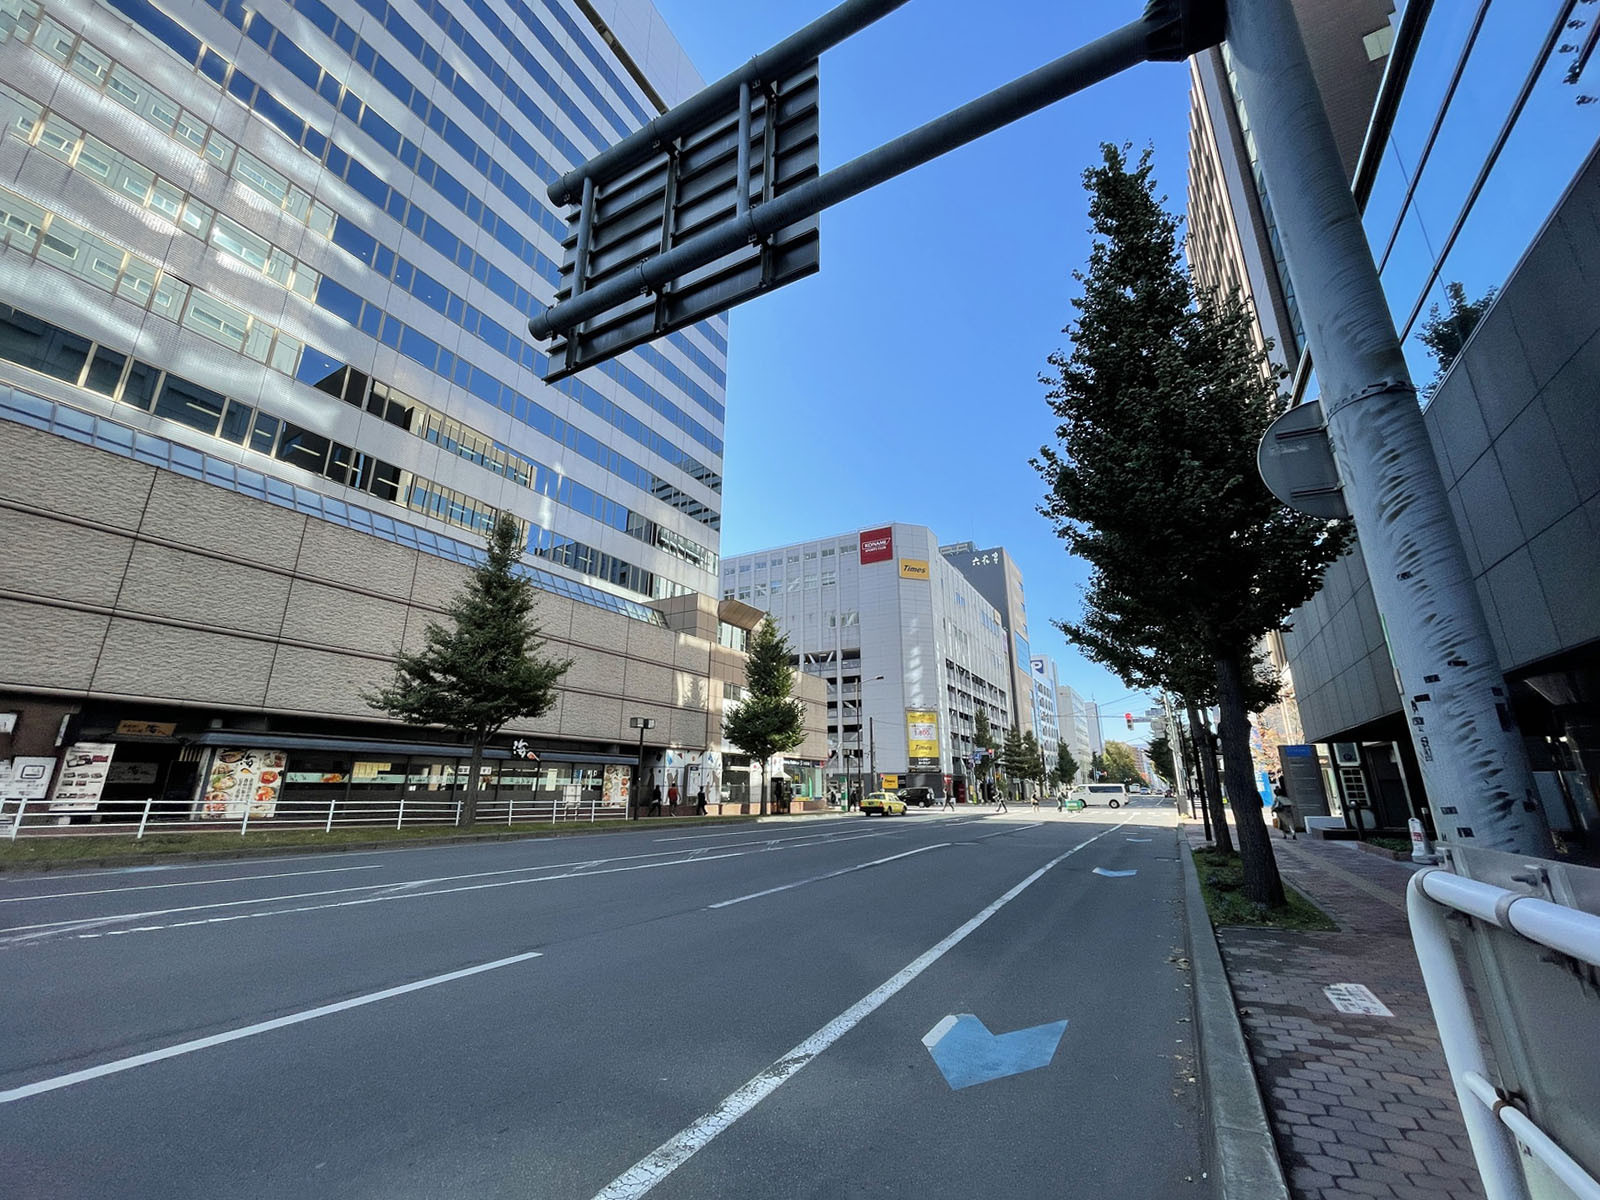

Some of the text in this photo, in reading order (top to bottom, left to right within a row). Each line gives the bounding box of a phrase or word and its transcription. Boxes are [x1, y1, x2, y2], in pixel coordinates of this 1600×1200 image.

[972, 551, 999, 566] 六花亭
[903, 564, 927, 574] Times
